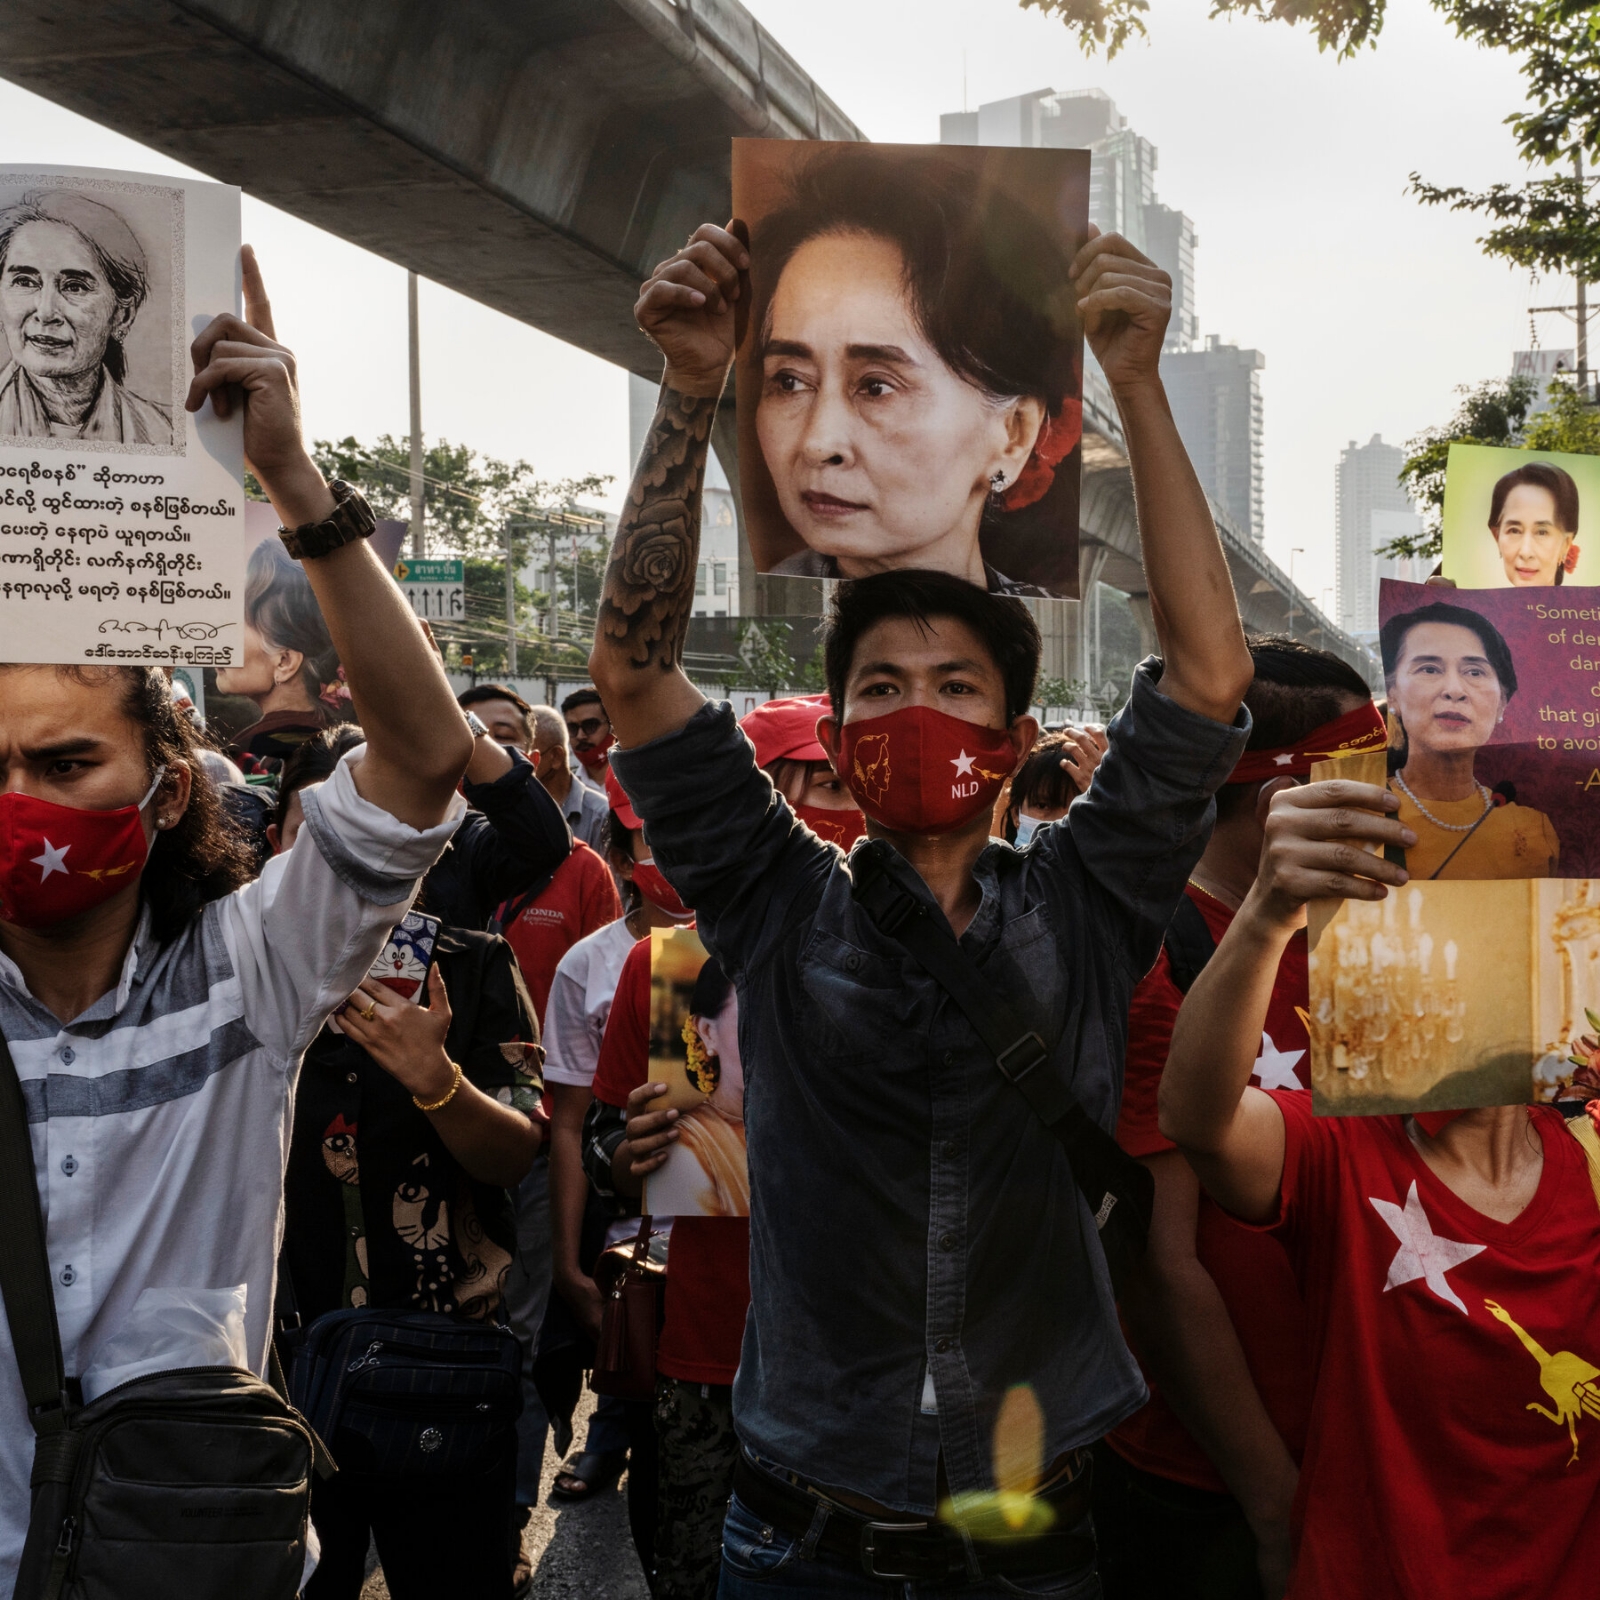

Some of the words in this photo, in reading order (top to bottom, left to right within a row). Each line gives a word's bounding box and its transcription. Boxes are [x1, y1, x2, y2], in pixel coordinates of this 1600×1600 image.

[1517, 352, 1573, 373] AIA
[93, 465, 165, 489] ဆိုတာဟာ
[130, 495, 236, 520] စနစ်ဖြစ်တယ်။
[55, 523, 109, 545] နေရာပဲ
[115, 524, 191, 547] ယူရတယ်။
[0, 547, 81, 572] ဏာရှိတိုင်း
[87, 550, 202, 577] လက်နက်ရှိတိုင်း
[78, 581, 120, 602] မရတဲ့
[126, 580, 231, 604] စနစ်ဖြစ်တယ်။
[1548, 628, 1567, 644] of
[1572, 629, 1600, 646] de
[84, 643, 234, 665] ဒေါ်အောင်ဆန်းစုကြည်
[1538, 704, 1578, 722] that
[1537, 735, 1557, 750] to
[951, 781, 979, 799] NLD
